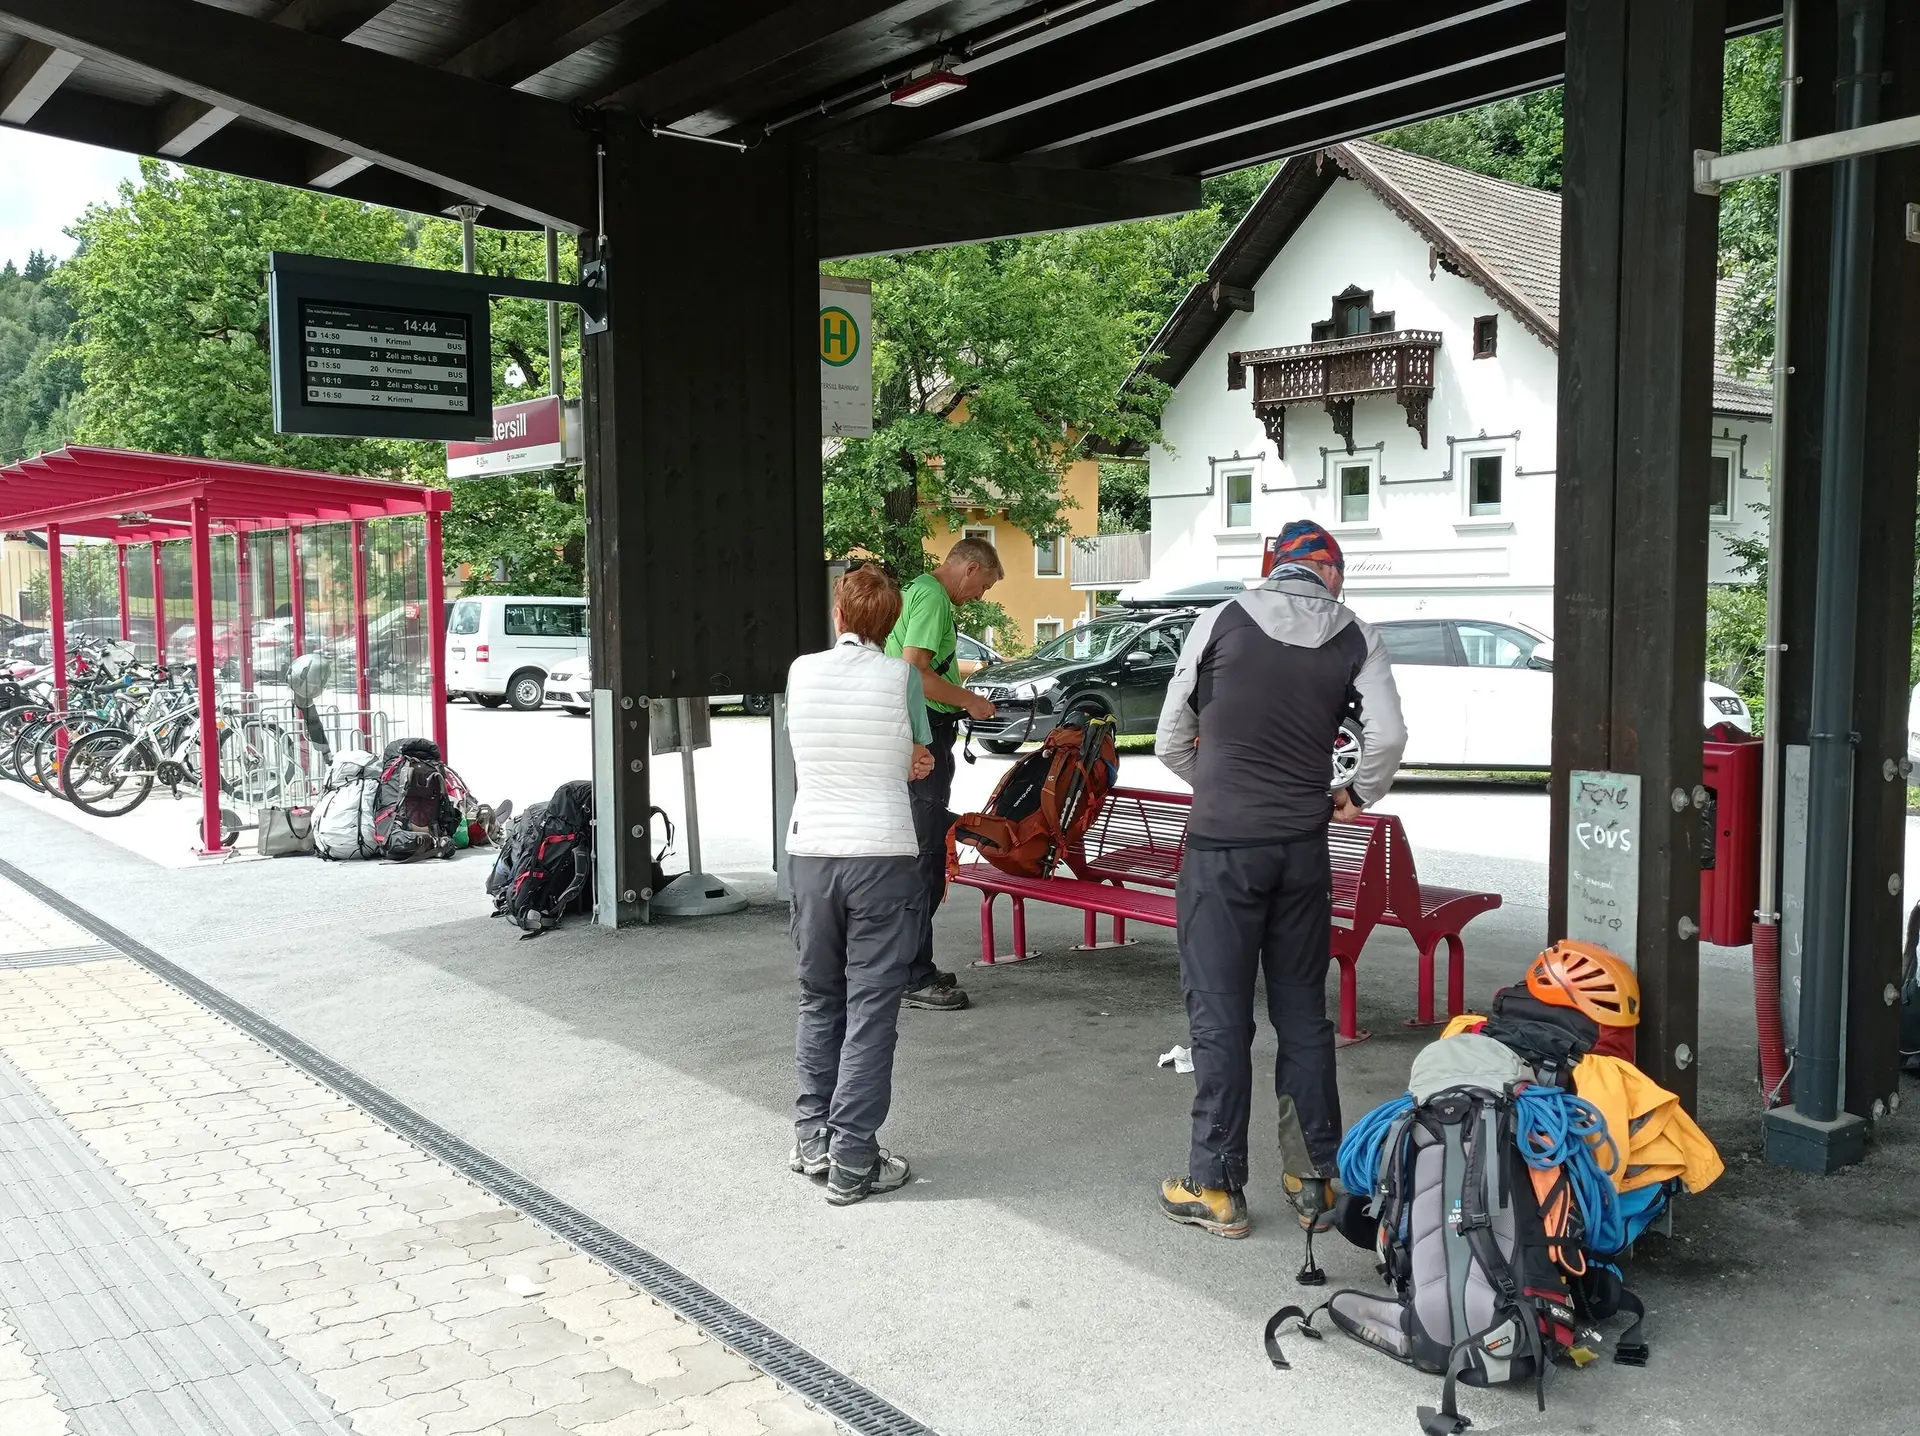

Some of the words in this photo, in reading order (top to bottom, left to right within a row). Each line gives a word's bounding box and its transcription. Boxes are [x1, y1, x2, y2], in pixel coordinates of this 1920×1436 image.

[404, 319, 437, 333] 14:44
[386, 337, 411, 346] Krimml
[824, 318, 847, 355] H
[386, 352, 399, 360] Zell
[414, 354, 427, 362] See
[321, 361, 341, 370] 15:50
[386, 366, 412, 375] Krimml
[321, 376, 342, 384] 16:10
[387, 381, 401, 389] Zell
[322, 391, 342, 399] 16:50
[387, 395, 413, 404] Krimml
[1576, 822, 1631, 852] FOVS
